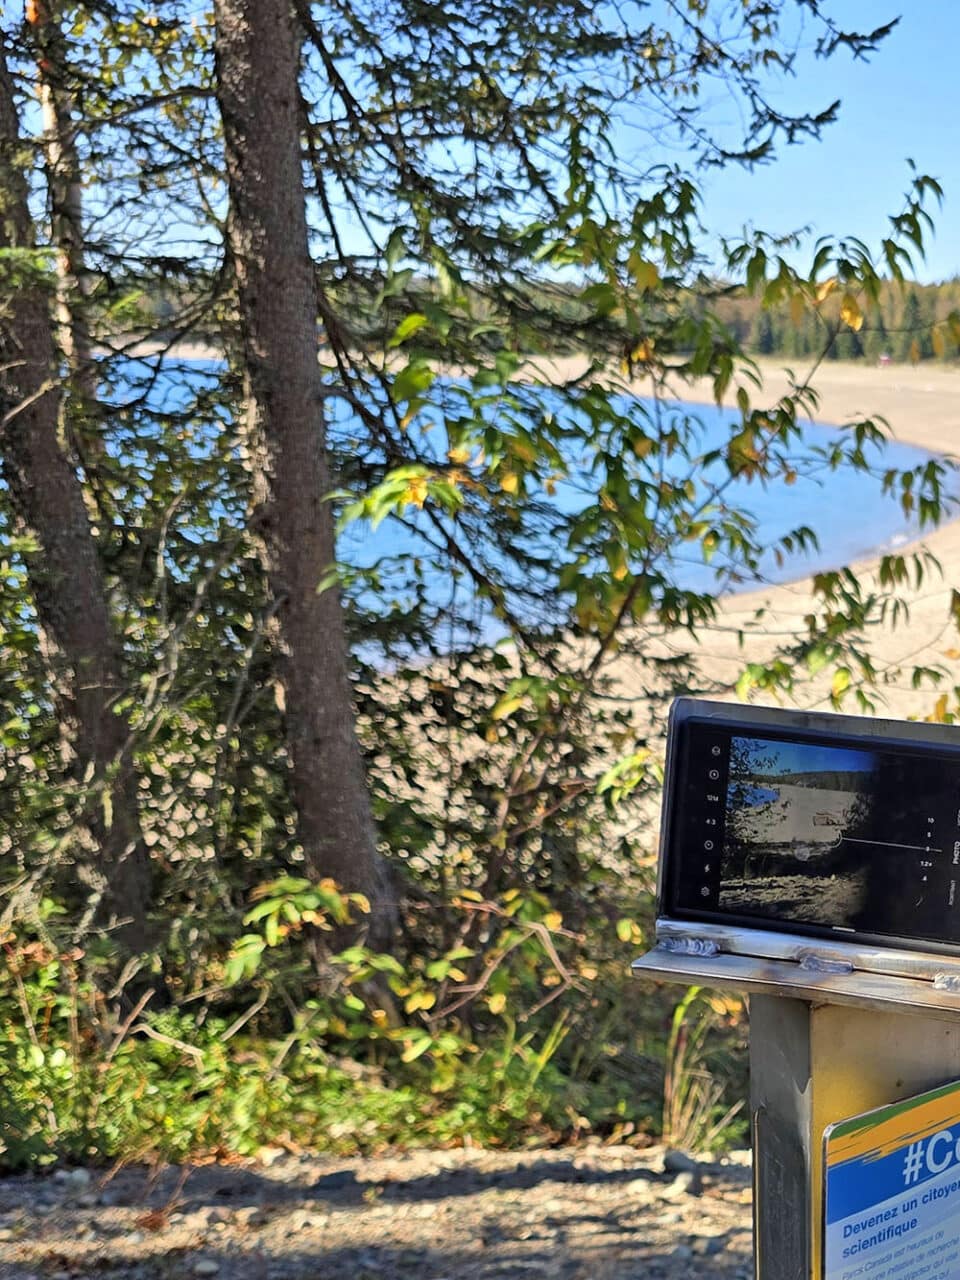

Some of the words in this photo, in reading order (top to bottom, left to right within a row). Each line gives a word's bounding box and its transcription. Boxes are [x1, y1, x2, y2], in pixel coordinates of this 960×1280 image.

[843, 1207, 898, 1239] Devenez
[902, 1199, 918, 1213] un
[843, 1218, 918, 1258] scientifique
